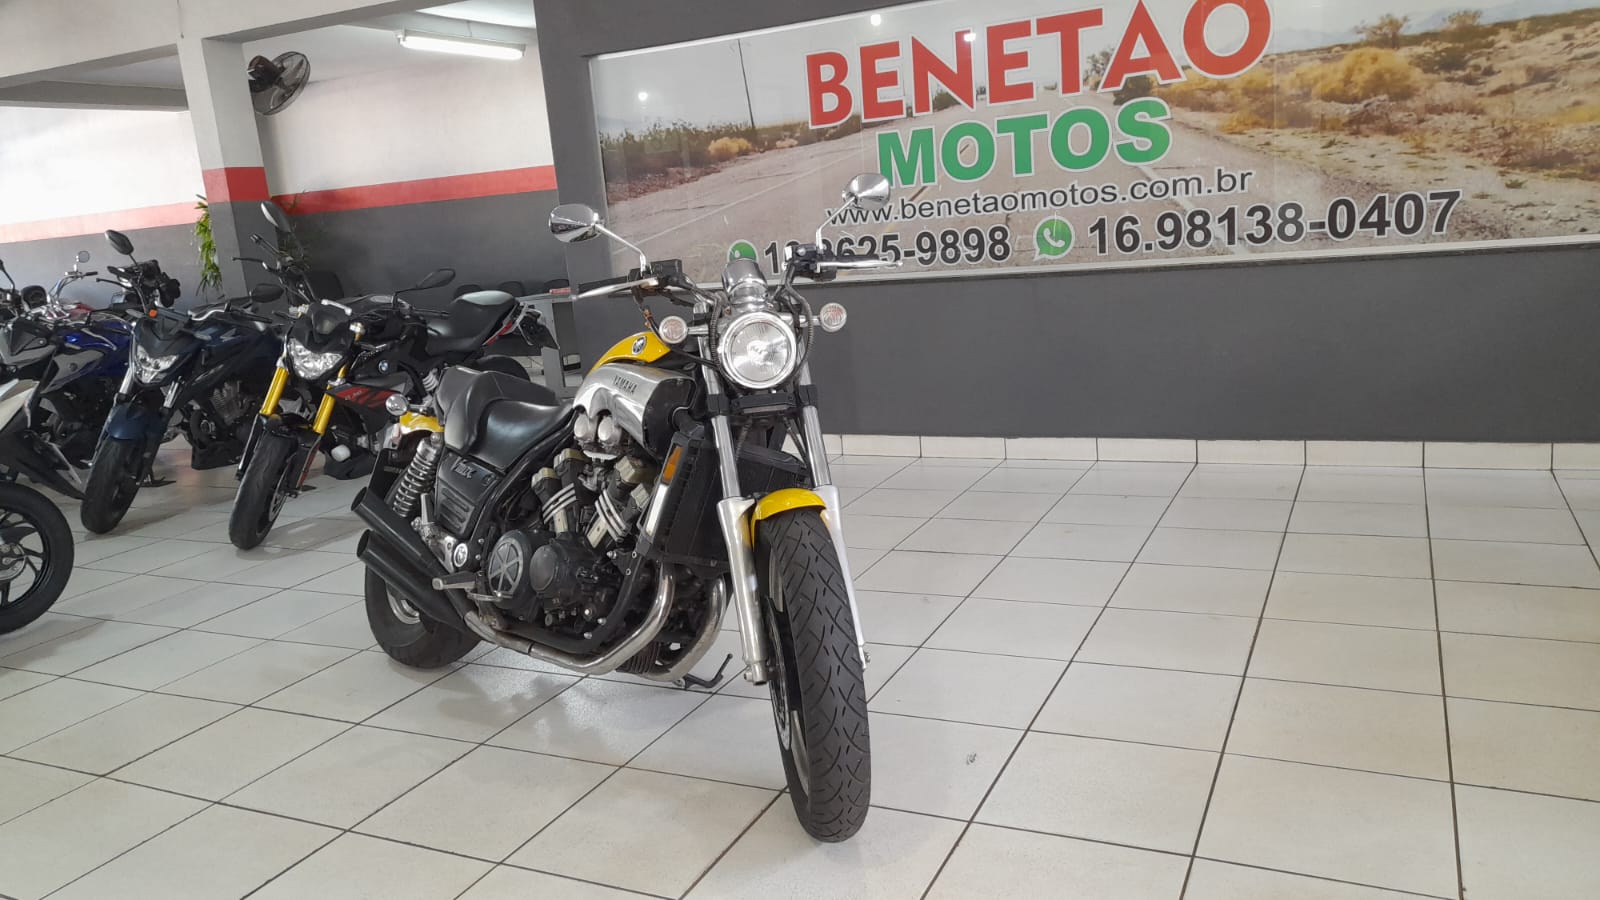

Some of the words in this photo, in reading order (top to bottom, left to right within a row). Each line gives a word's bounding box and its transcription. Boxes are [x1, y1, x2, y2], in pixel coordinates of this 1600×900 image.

[806, 0, 1271, 126] BENETAO
[877, 100, 1171, 187] MOTOS
[827, 169, 1253, 225] www.benetaomotos.com.br
[1088, 190, 1461, 255] 16.98138-0407
[765, 226, 1011, 274] 1625-9898
